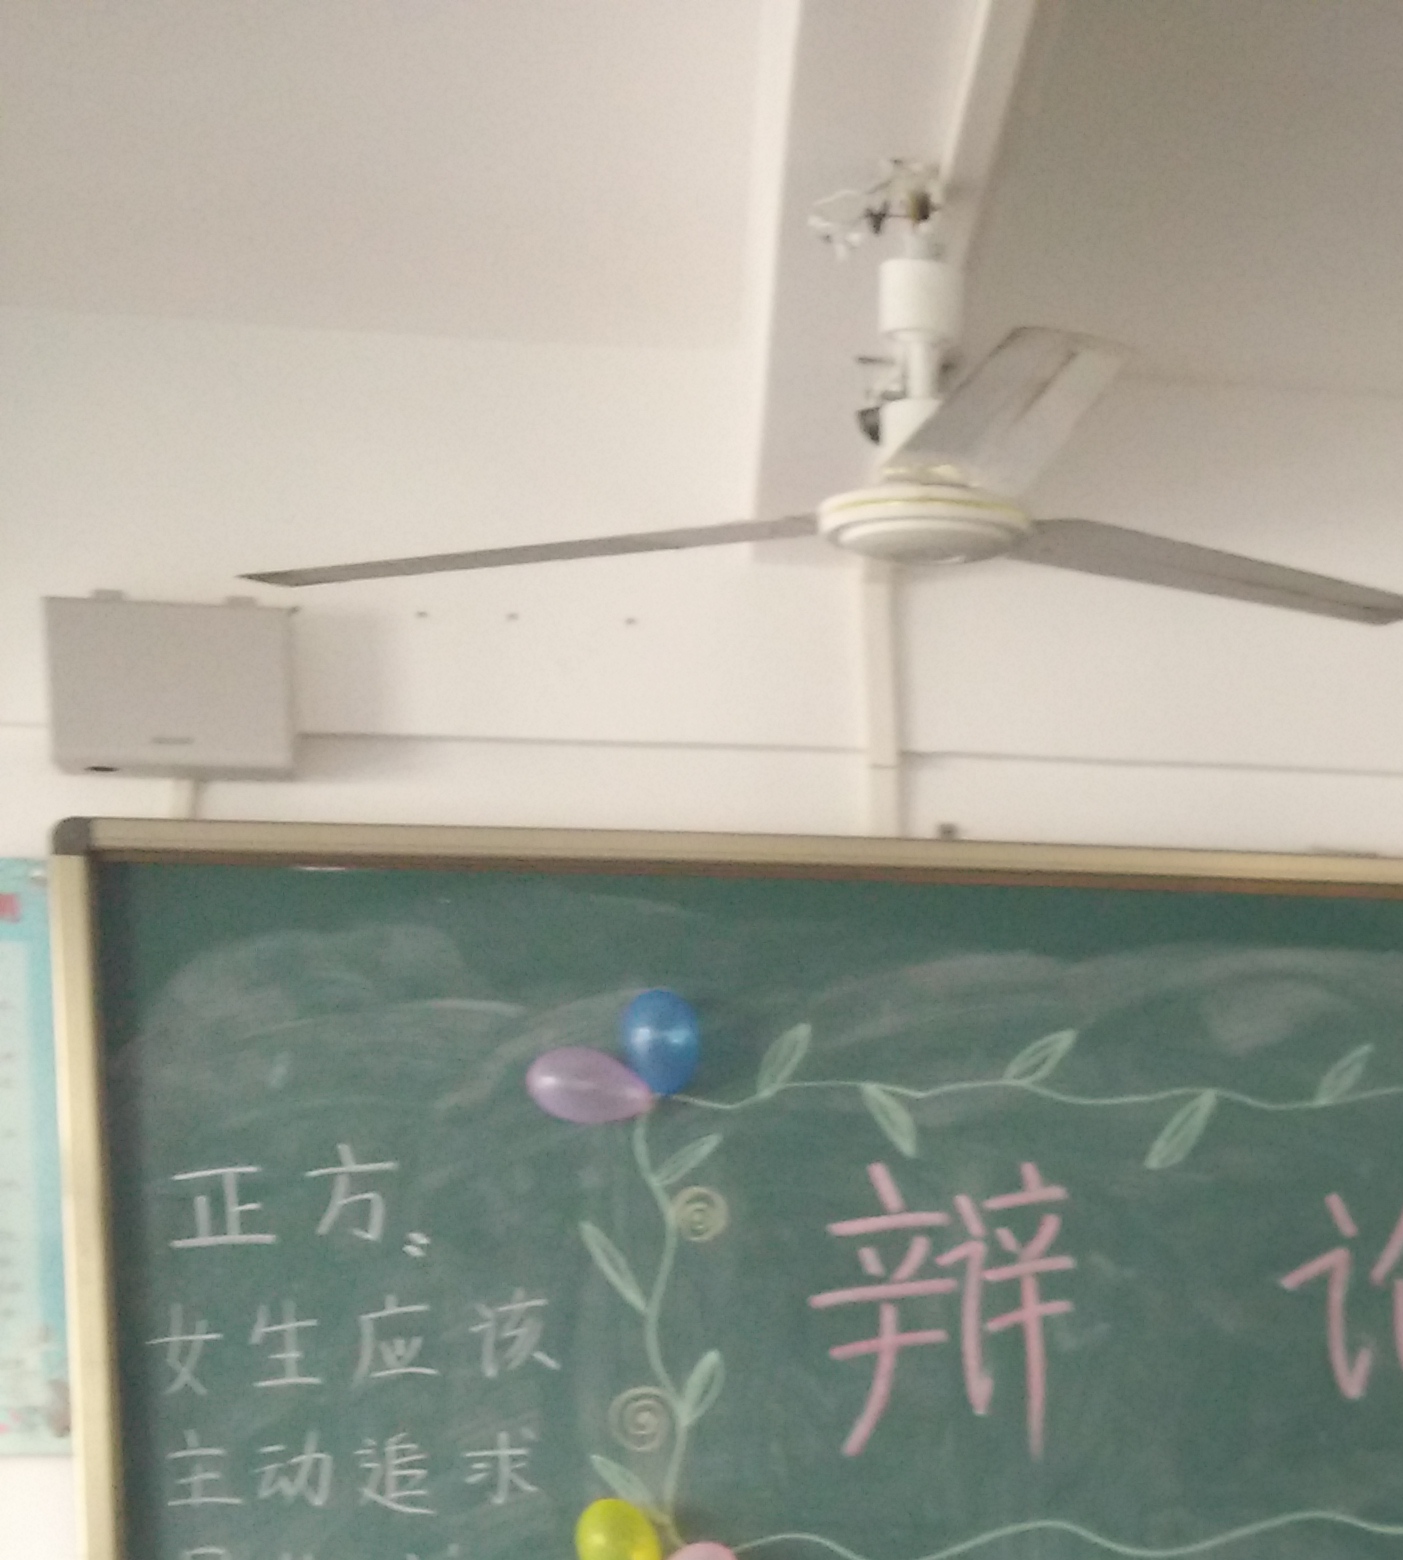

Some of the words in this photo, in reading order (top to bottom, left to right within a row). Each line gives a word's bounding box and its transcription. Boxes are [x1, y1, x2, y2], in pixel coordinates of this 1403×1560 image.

[144, 1287, 562, 1396] 女生应该
[165, 1430, 540, 1517] 主动追求
